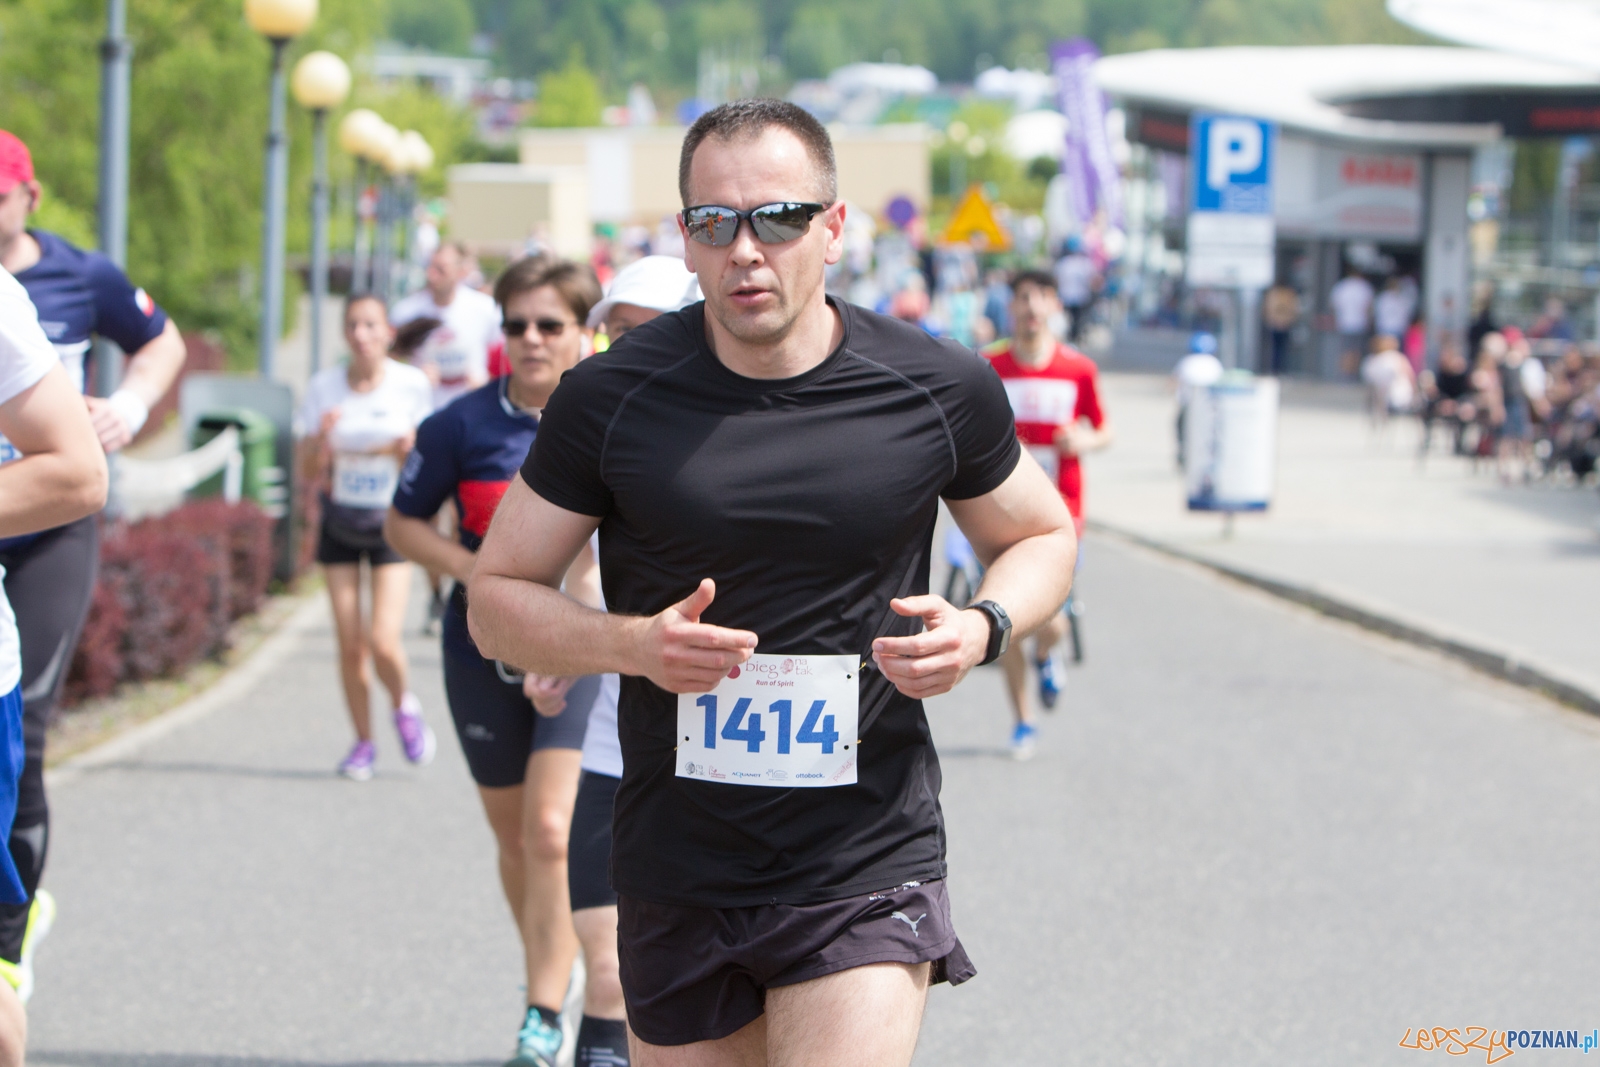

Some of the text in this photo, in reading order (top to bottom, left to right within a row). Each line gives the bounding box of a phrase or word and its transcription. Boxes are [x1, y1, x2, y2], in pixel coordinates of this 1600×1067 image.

[1206, 119, 1264, 190] P
[745, 660, 779, 679] bieg
[796, 666, 813, 675] tak
[696, 694, 838, 754] 1414
